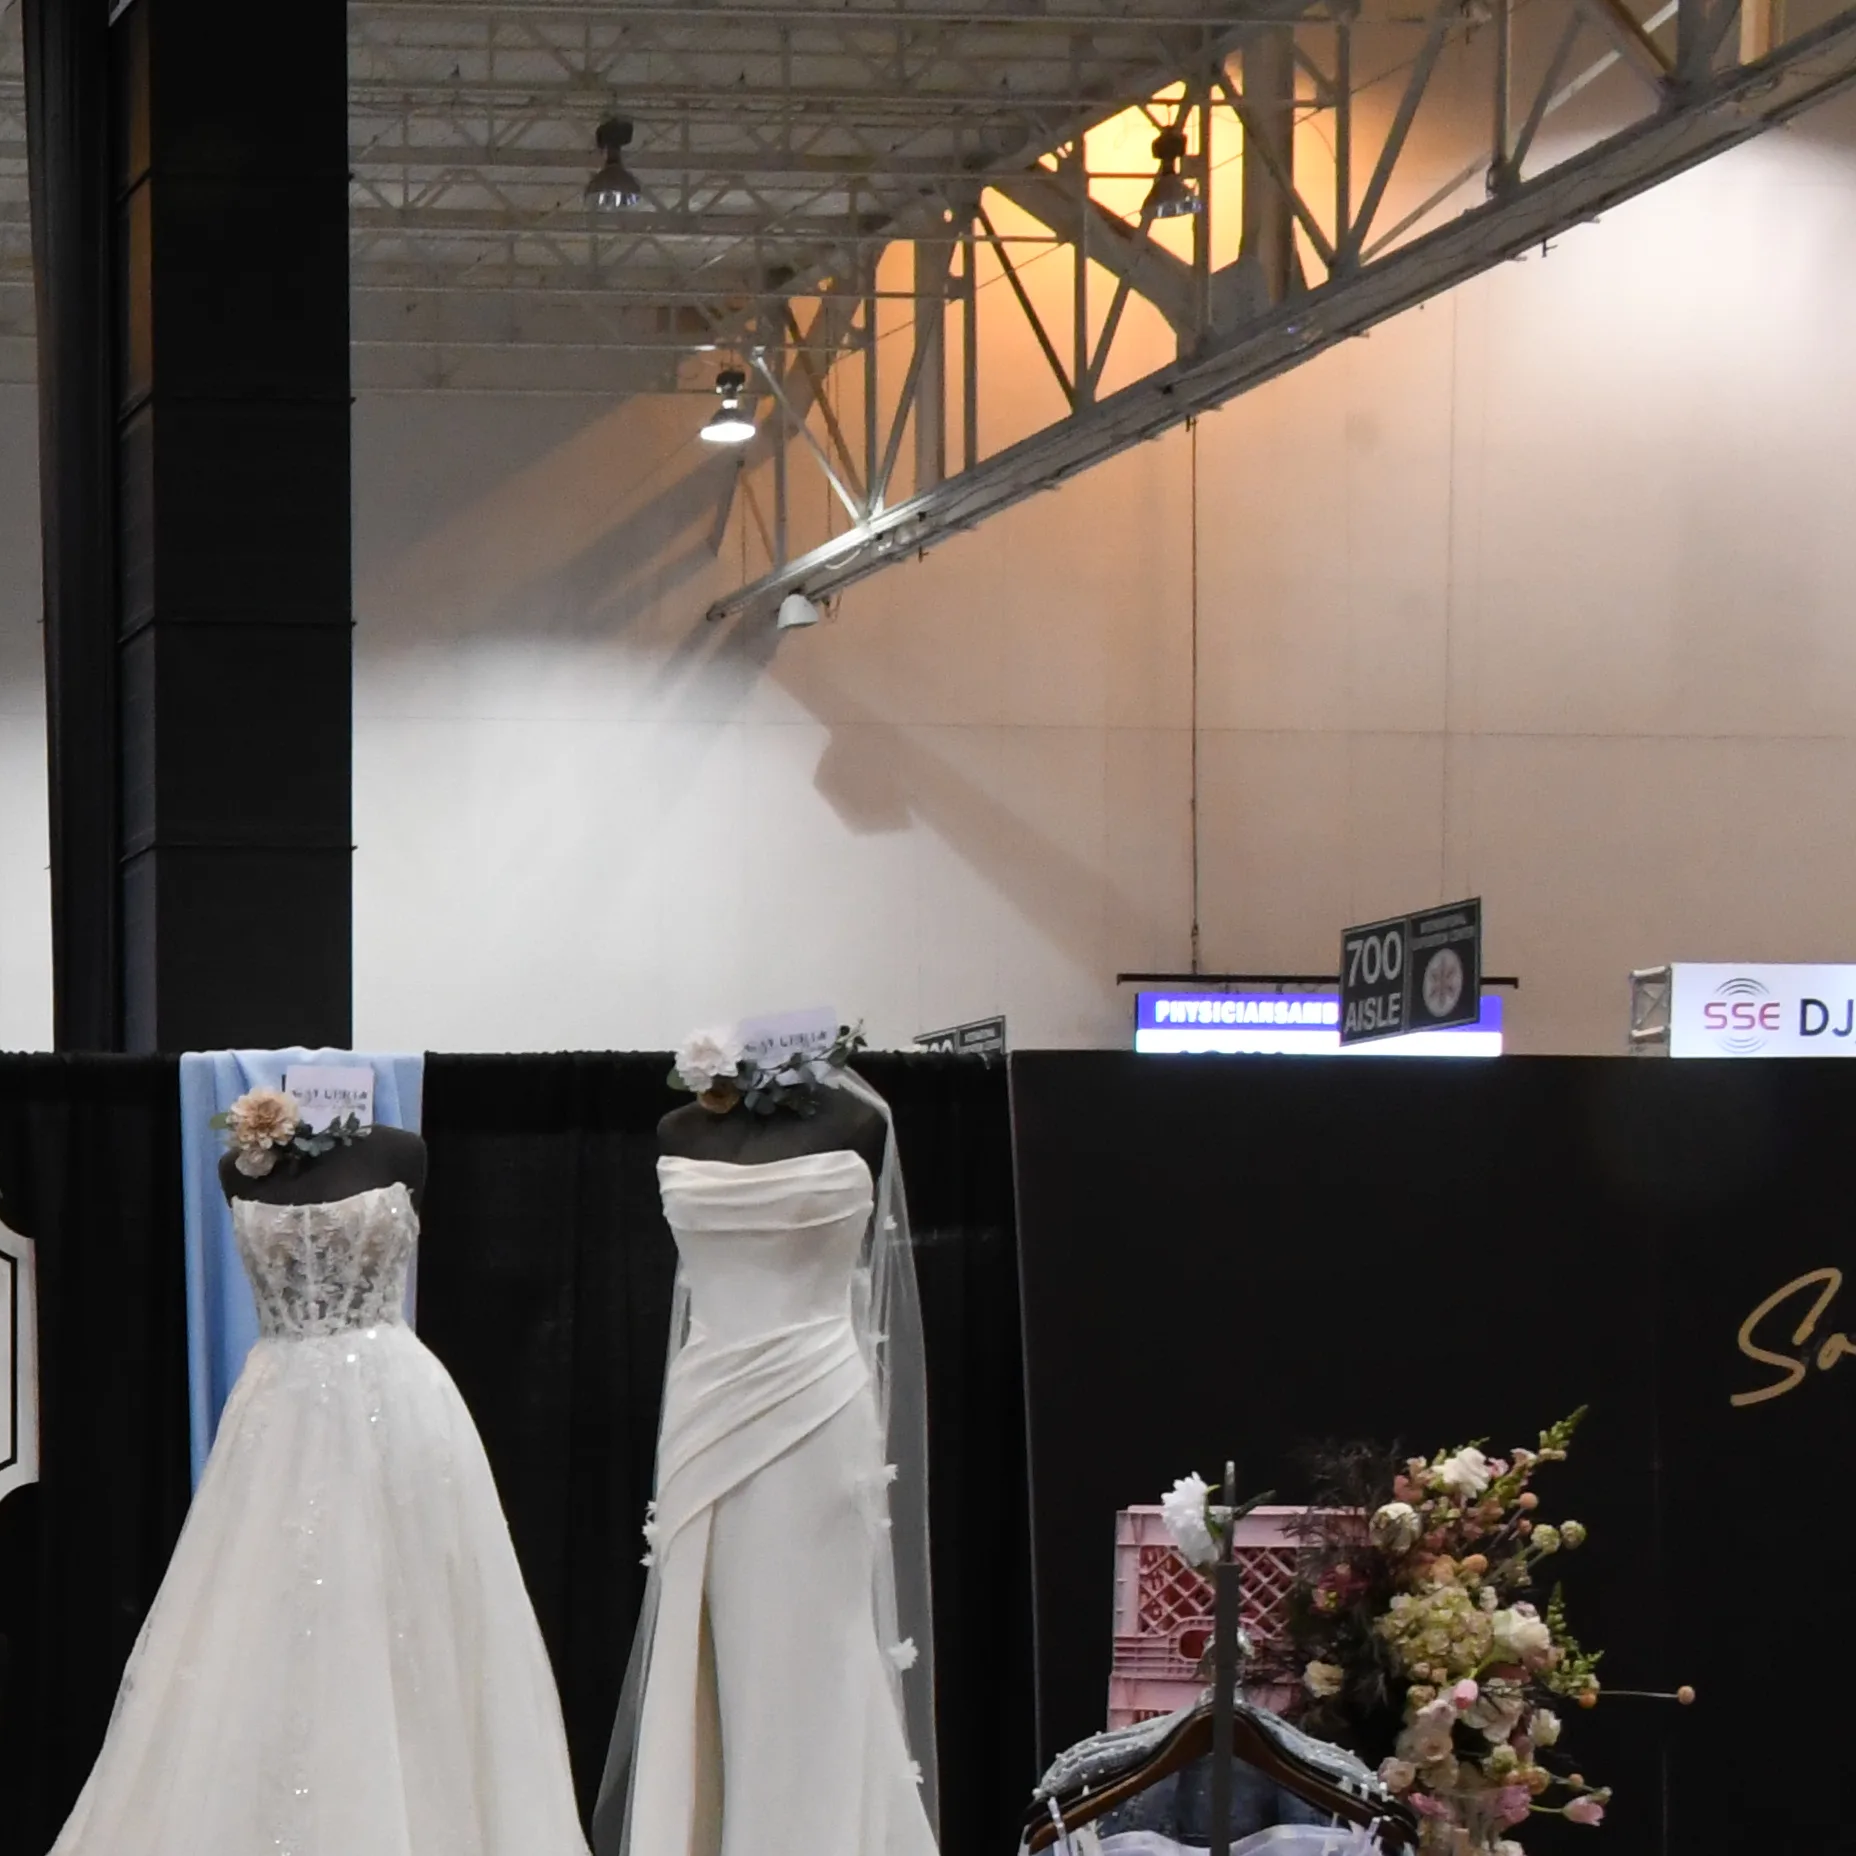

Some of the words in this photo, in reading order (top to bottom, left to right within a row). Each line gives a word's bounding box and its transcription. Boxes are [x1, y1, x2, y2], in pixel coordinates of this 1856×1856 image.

[1346, 930, 1403, 988] 700
[1344, 992, 1402, 1034] AISLE
[1703, 1002, 1781, 1031] SSE
